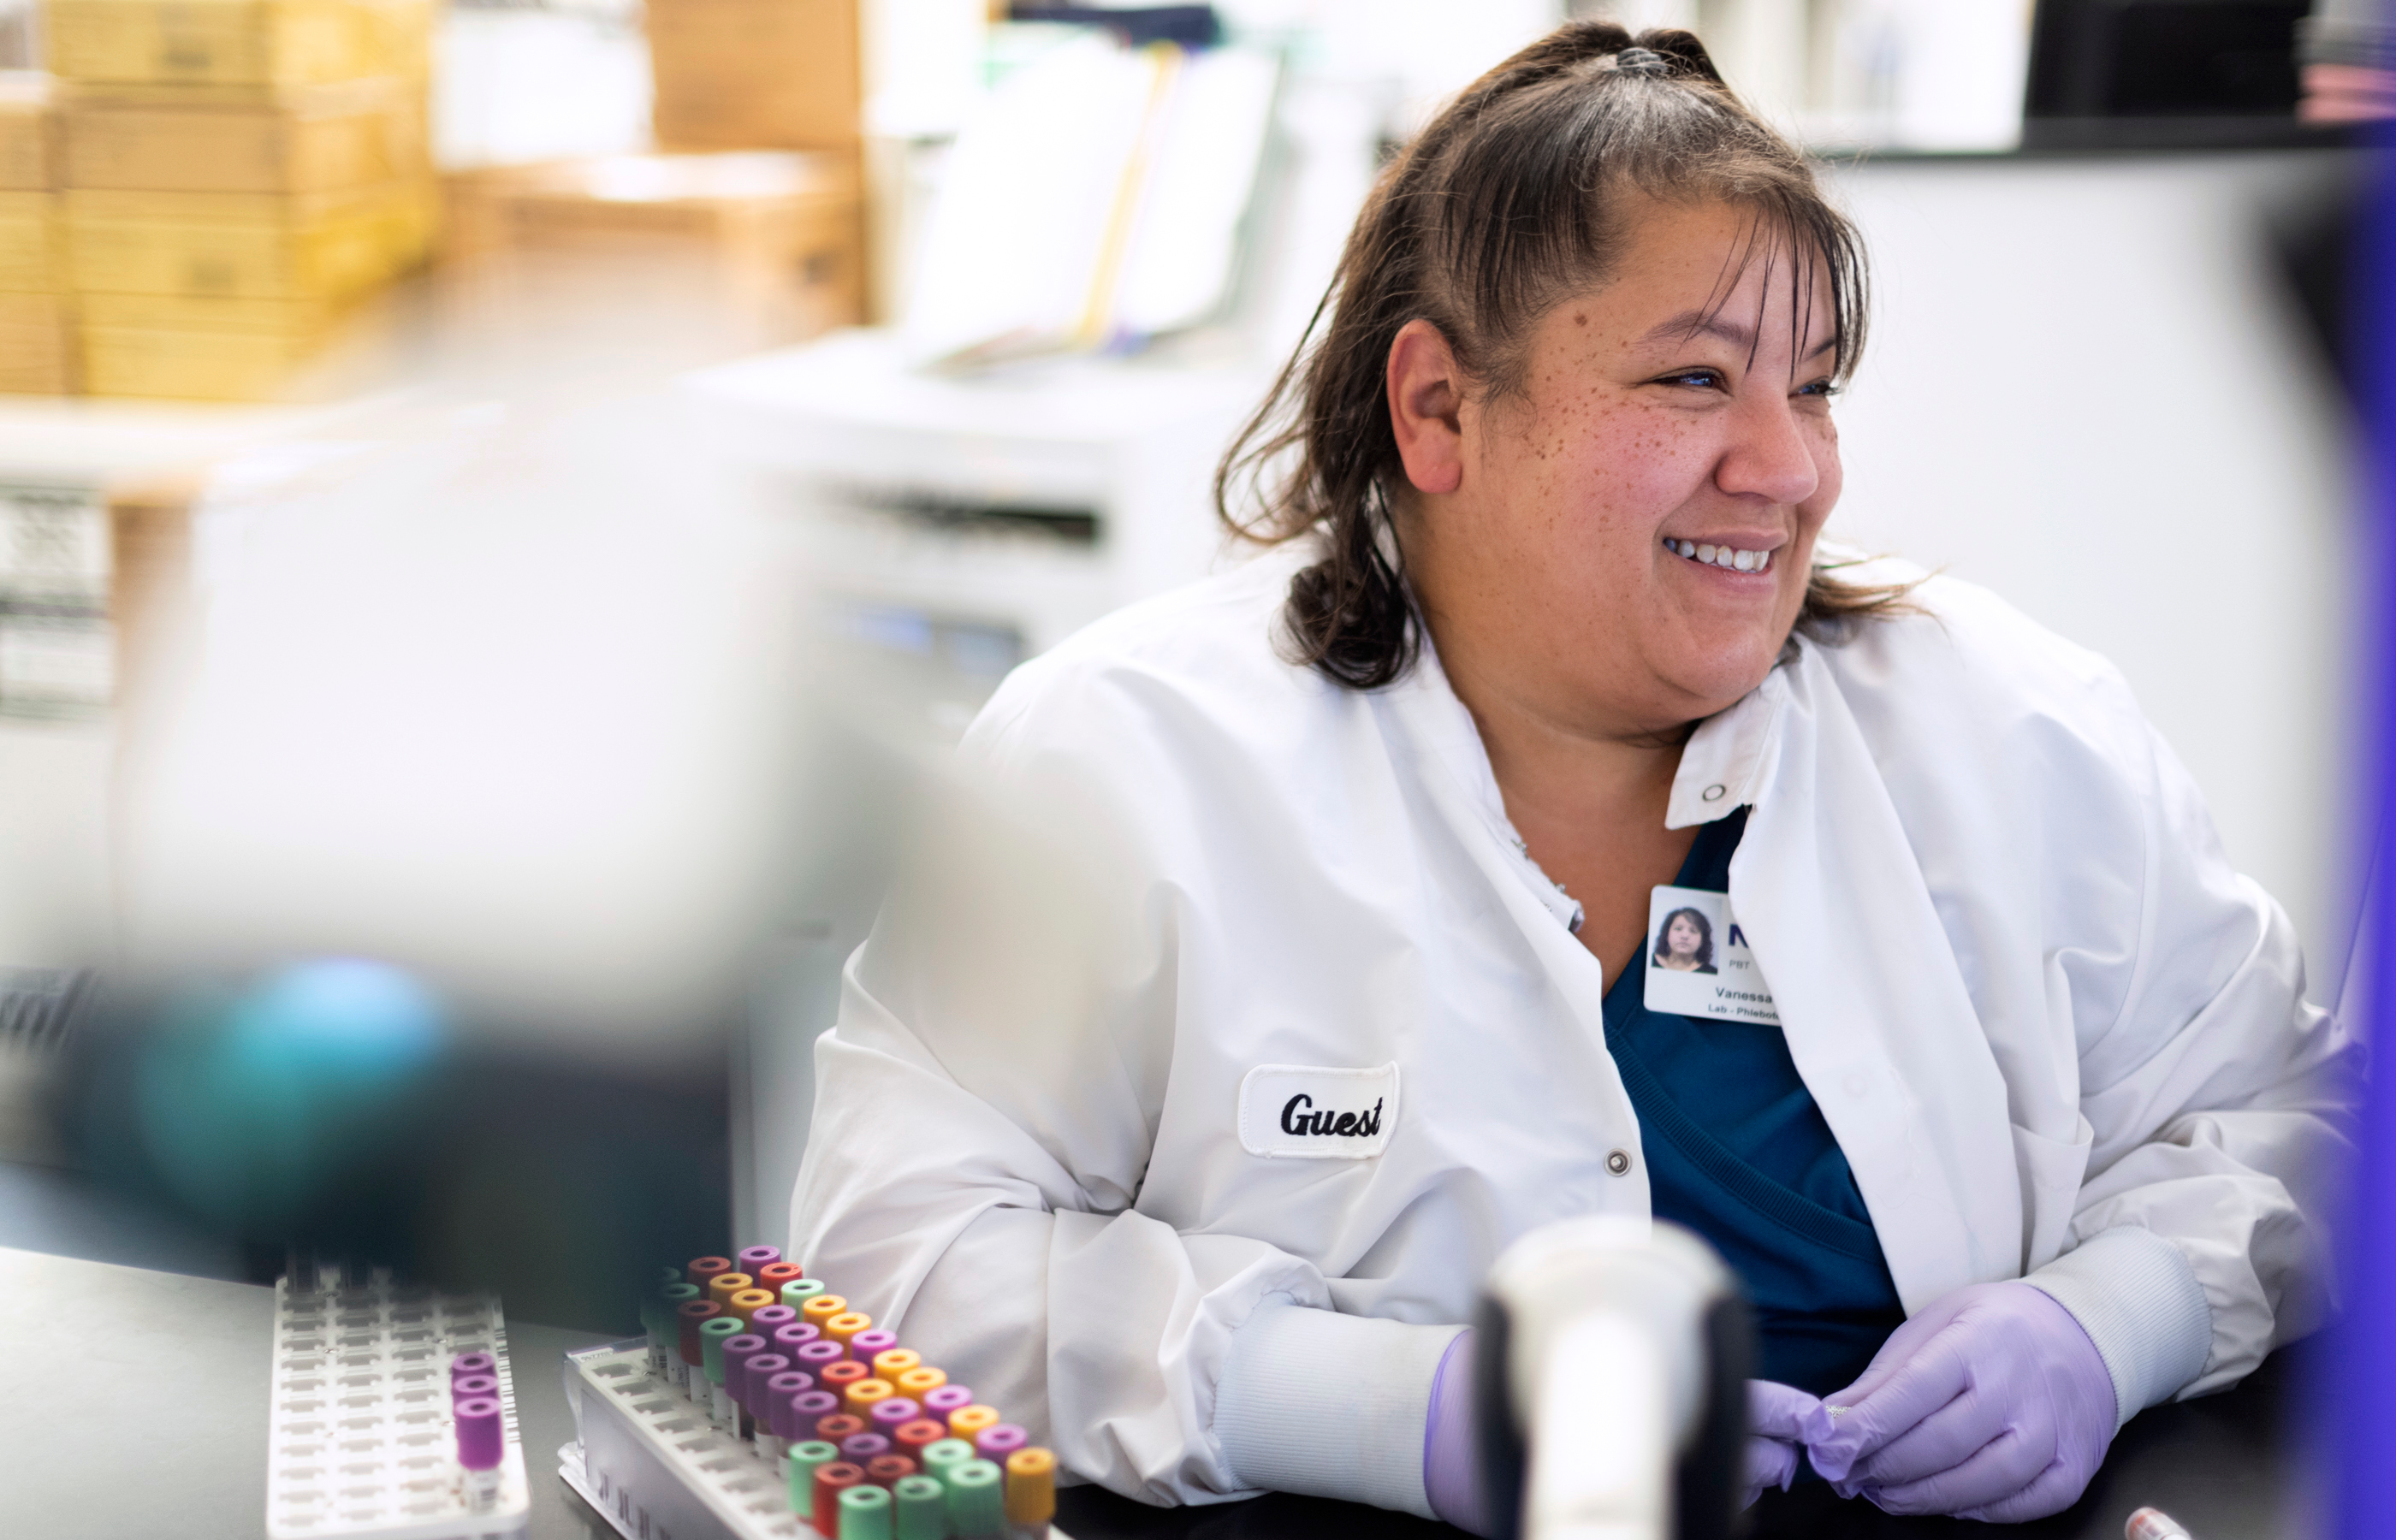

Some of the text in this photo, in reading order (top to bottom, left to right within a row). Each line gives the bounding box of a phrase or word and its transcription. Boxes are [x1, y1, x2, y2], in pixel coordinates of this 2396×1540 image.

[1729, 959, 1750, 970] PBT
[1716, 986, 1773, 1004] Vanessa
[1708, 1004, 1728, 1015] Lab
[1280, 1093, 1384, 1138] Guest
